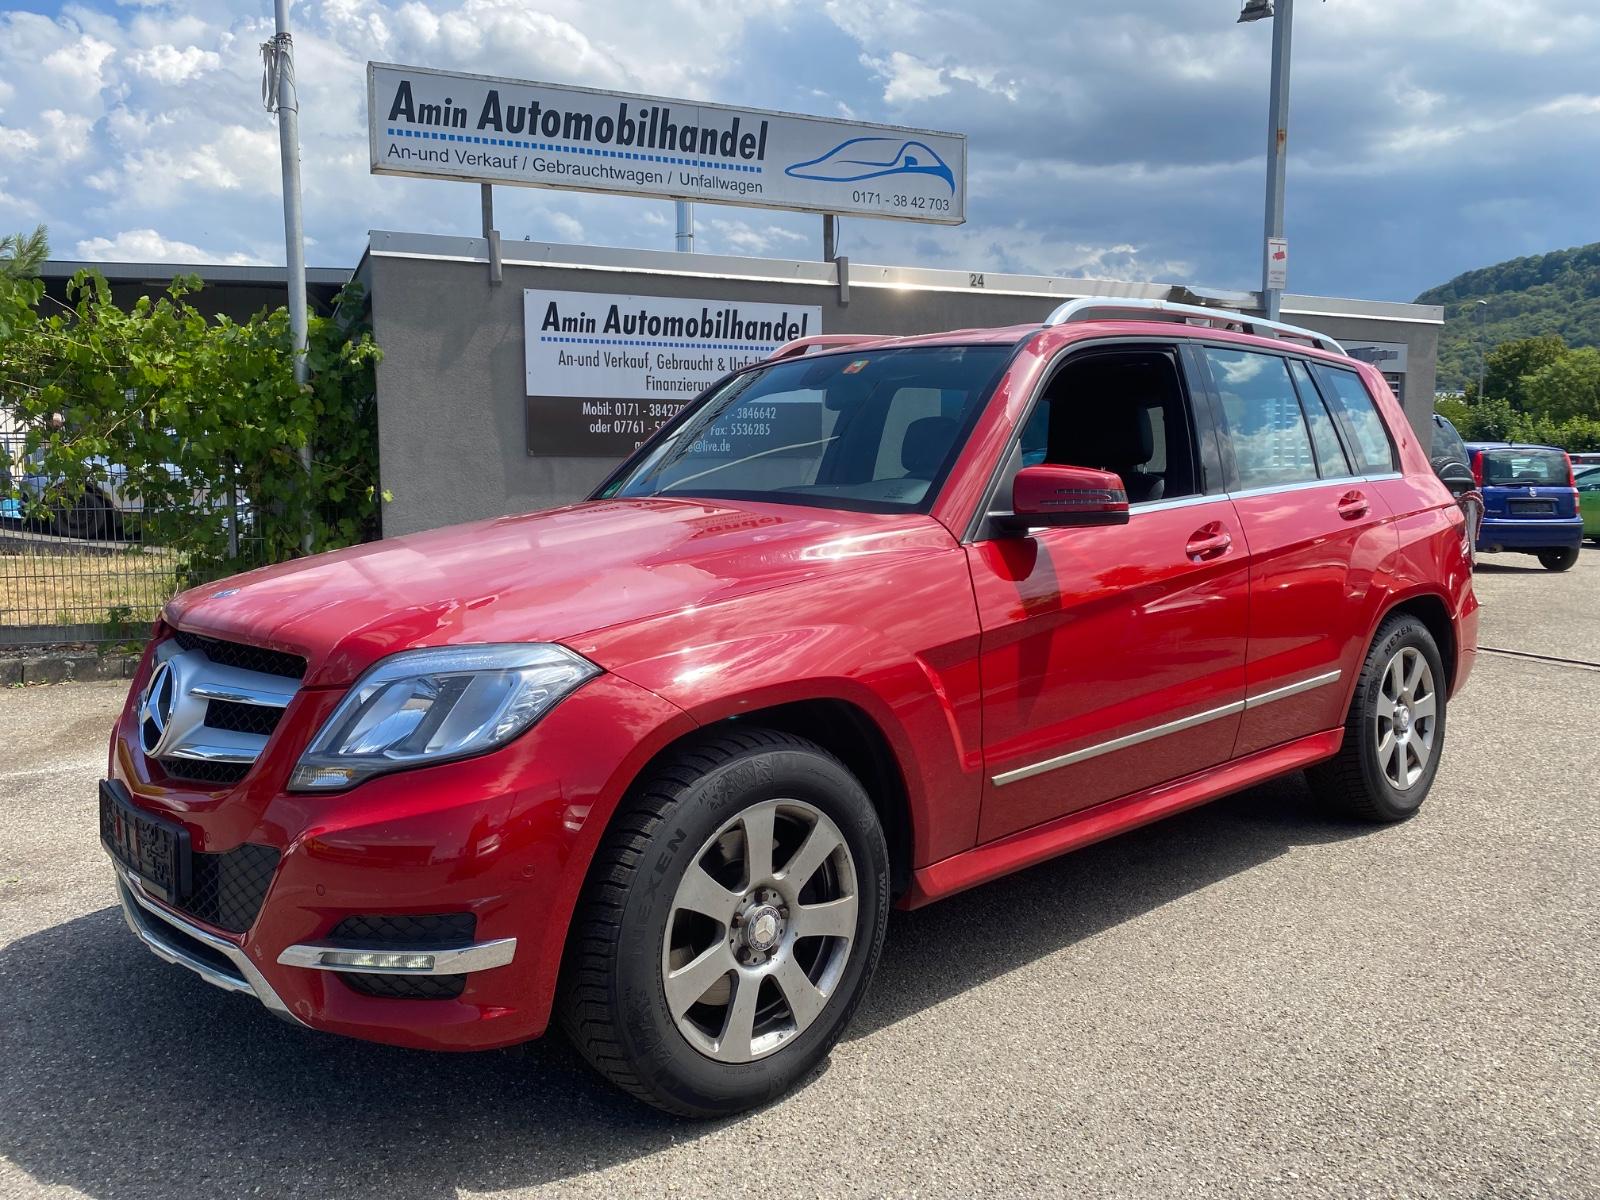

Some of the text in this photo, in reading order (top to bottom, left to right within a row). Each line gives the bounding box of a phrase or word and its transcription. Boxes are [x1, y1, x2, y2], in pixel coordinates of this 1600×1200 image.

[388, 80, 768, 161] Amin Automobilhandel
[387, 143, 763, 194] An-und Verkauf / Gebrauchtwagen / Unfallwagen
[852, 190, 881, 205] 0171
[893, 194, 908, 207] 38
[910, 197, 926, 209] 42
[929, 198, 950, 211] 703
[969, 273, 985, 288] 24
[541, 301, 808, 341] Amin Automobilhandel
[558, 349, 600, 367] An-und
[604, 351, 653, 372] Verkauf,
[656, 353, 713, 371] Gebraucht
[717, 356, 726, 371] &
[582, 402, 612, 416] Mobil:
[615, 403, 639, 416] 0171
[649, 403, 686, 417] 38427
[736, 407, 777, 419] 3846642
[589, 419, 611, 433] oder
[614, 420, 644, 433] 07761
[730, 423, 771, 436] 5536285
[687, 438, 731, 453] e@live.de
